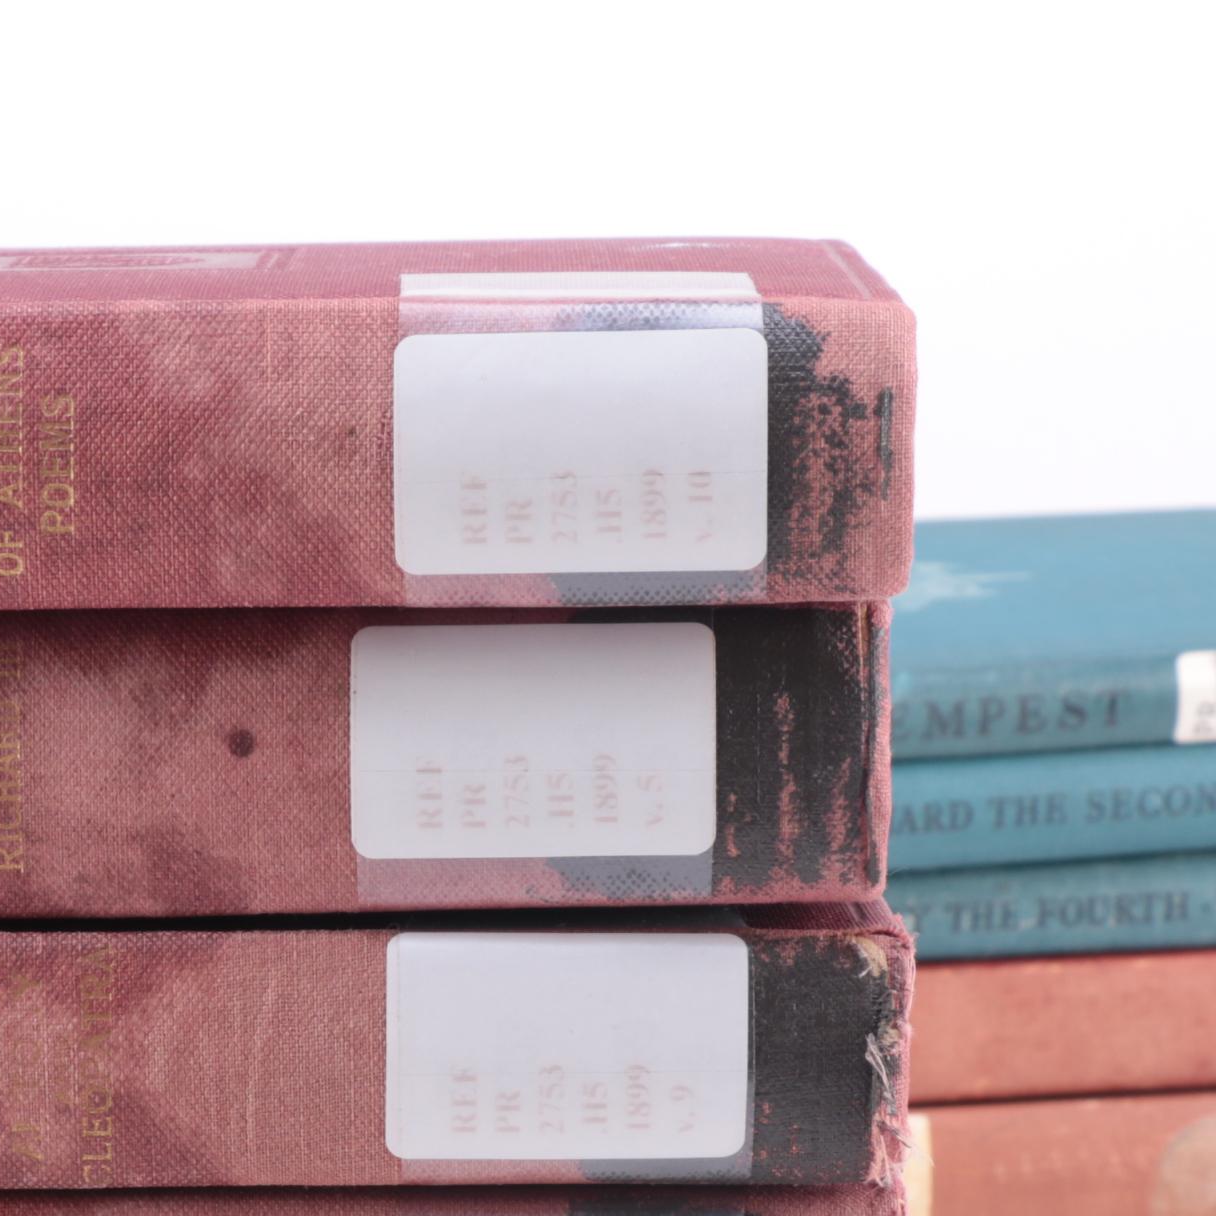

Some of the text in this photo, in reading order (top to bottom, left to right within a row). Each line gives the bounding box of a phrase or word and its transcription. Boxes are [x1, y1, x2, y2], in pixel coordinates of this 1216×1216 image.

[39, 393, 76, 535] POEMS
[686, 469, 715, 504] 10
[503, 496, 533, 544] PR
[550, 468, 578, 544] 2753
[640, 467, 668, 540] 1899
[460, 783, 489, 830] PR
[503, 753, 531, 829] 2753
[593, 753, 620, 825] 1899
[635, 773, 664, 793] 5
[988, 793, 1069, 830] THE
[946, 899, 1020, 933] THE
[1036, 891, 1191, 929] FOURTH
[494, 1088, 523, 1135] PR
[536, 1062, 567, 1135] 2753
[623, 1061, 652, 1131] 1899
[668, 1083, 695, 1104] 9
